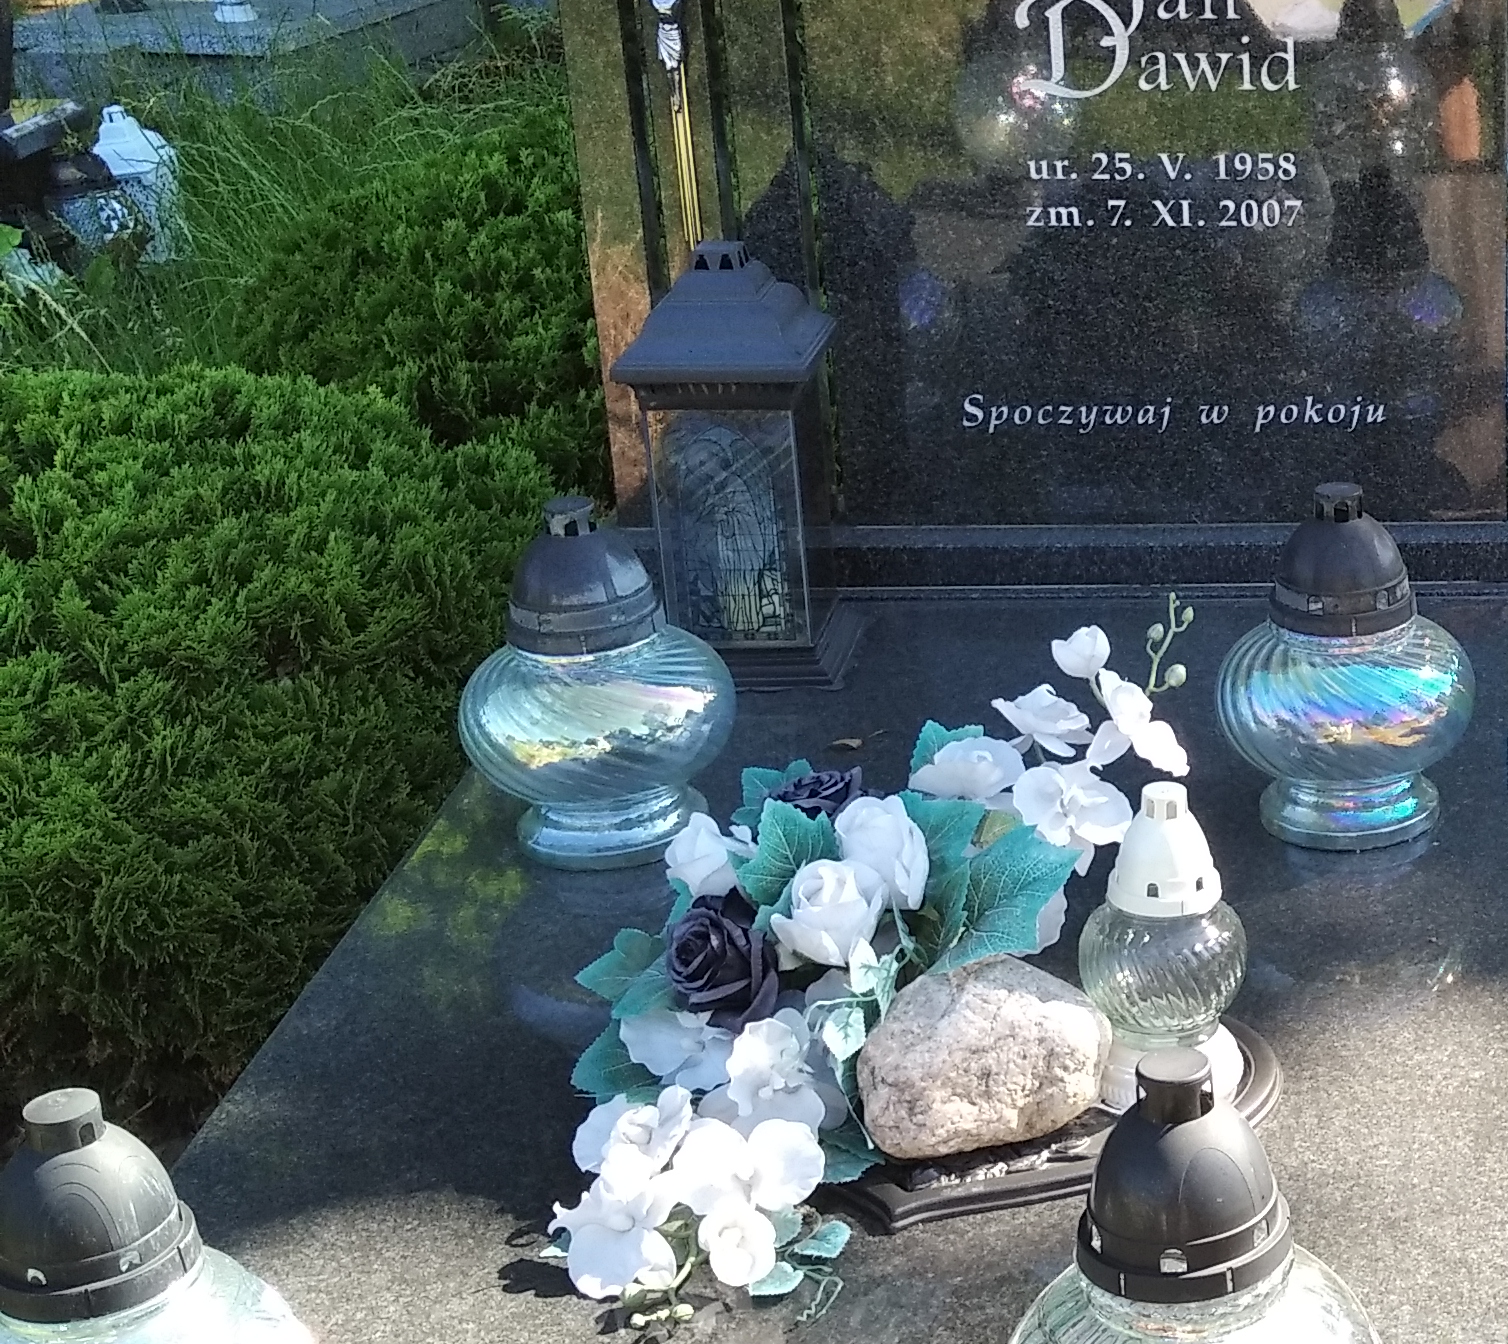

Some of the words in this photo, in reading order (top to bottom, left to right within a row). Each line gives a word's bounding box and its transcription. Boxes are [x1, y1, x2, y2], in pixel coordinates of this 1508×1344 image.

[1027, 157, 1079, 181] ur.
[1091, 152, 1146, 181] 25.
[1157, 152, 1193, 181] V.
[1212, 151, 1298, 181] 1958
[1025, 205, 1095, 227] zm.
[1107, 199, 1133, 227] 7.
[1151, 199, 1206, 227] XI.
[1218, 199, 1304, 228] 2007
[962, 393, 1174, 434] Spoczywaj
[1199, 403, 1230, 425] w
[1253, 394, 1388, 433] pokoju
